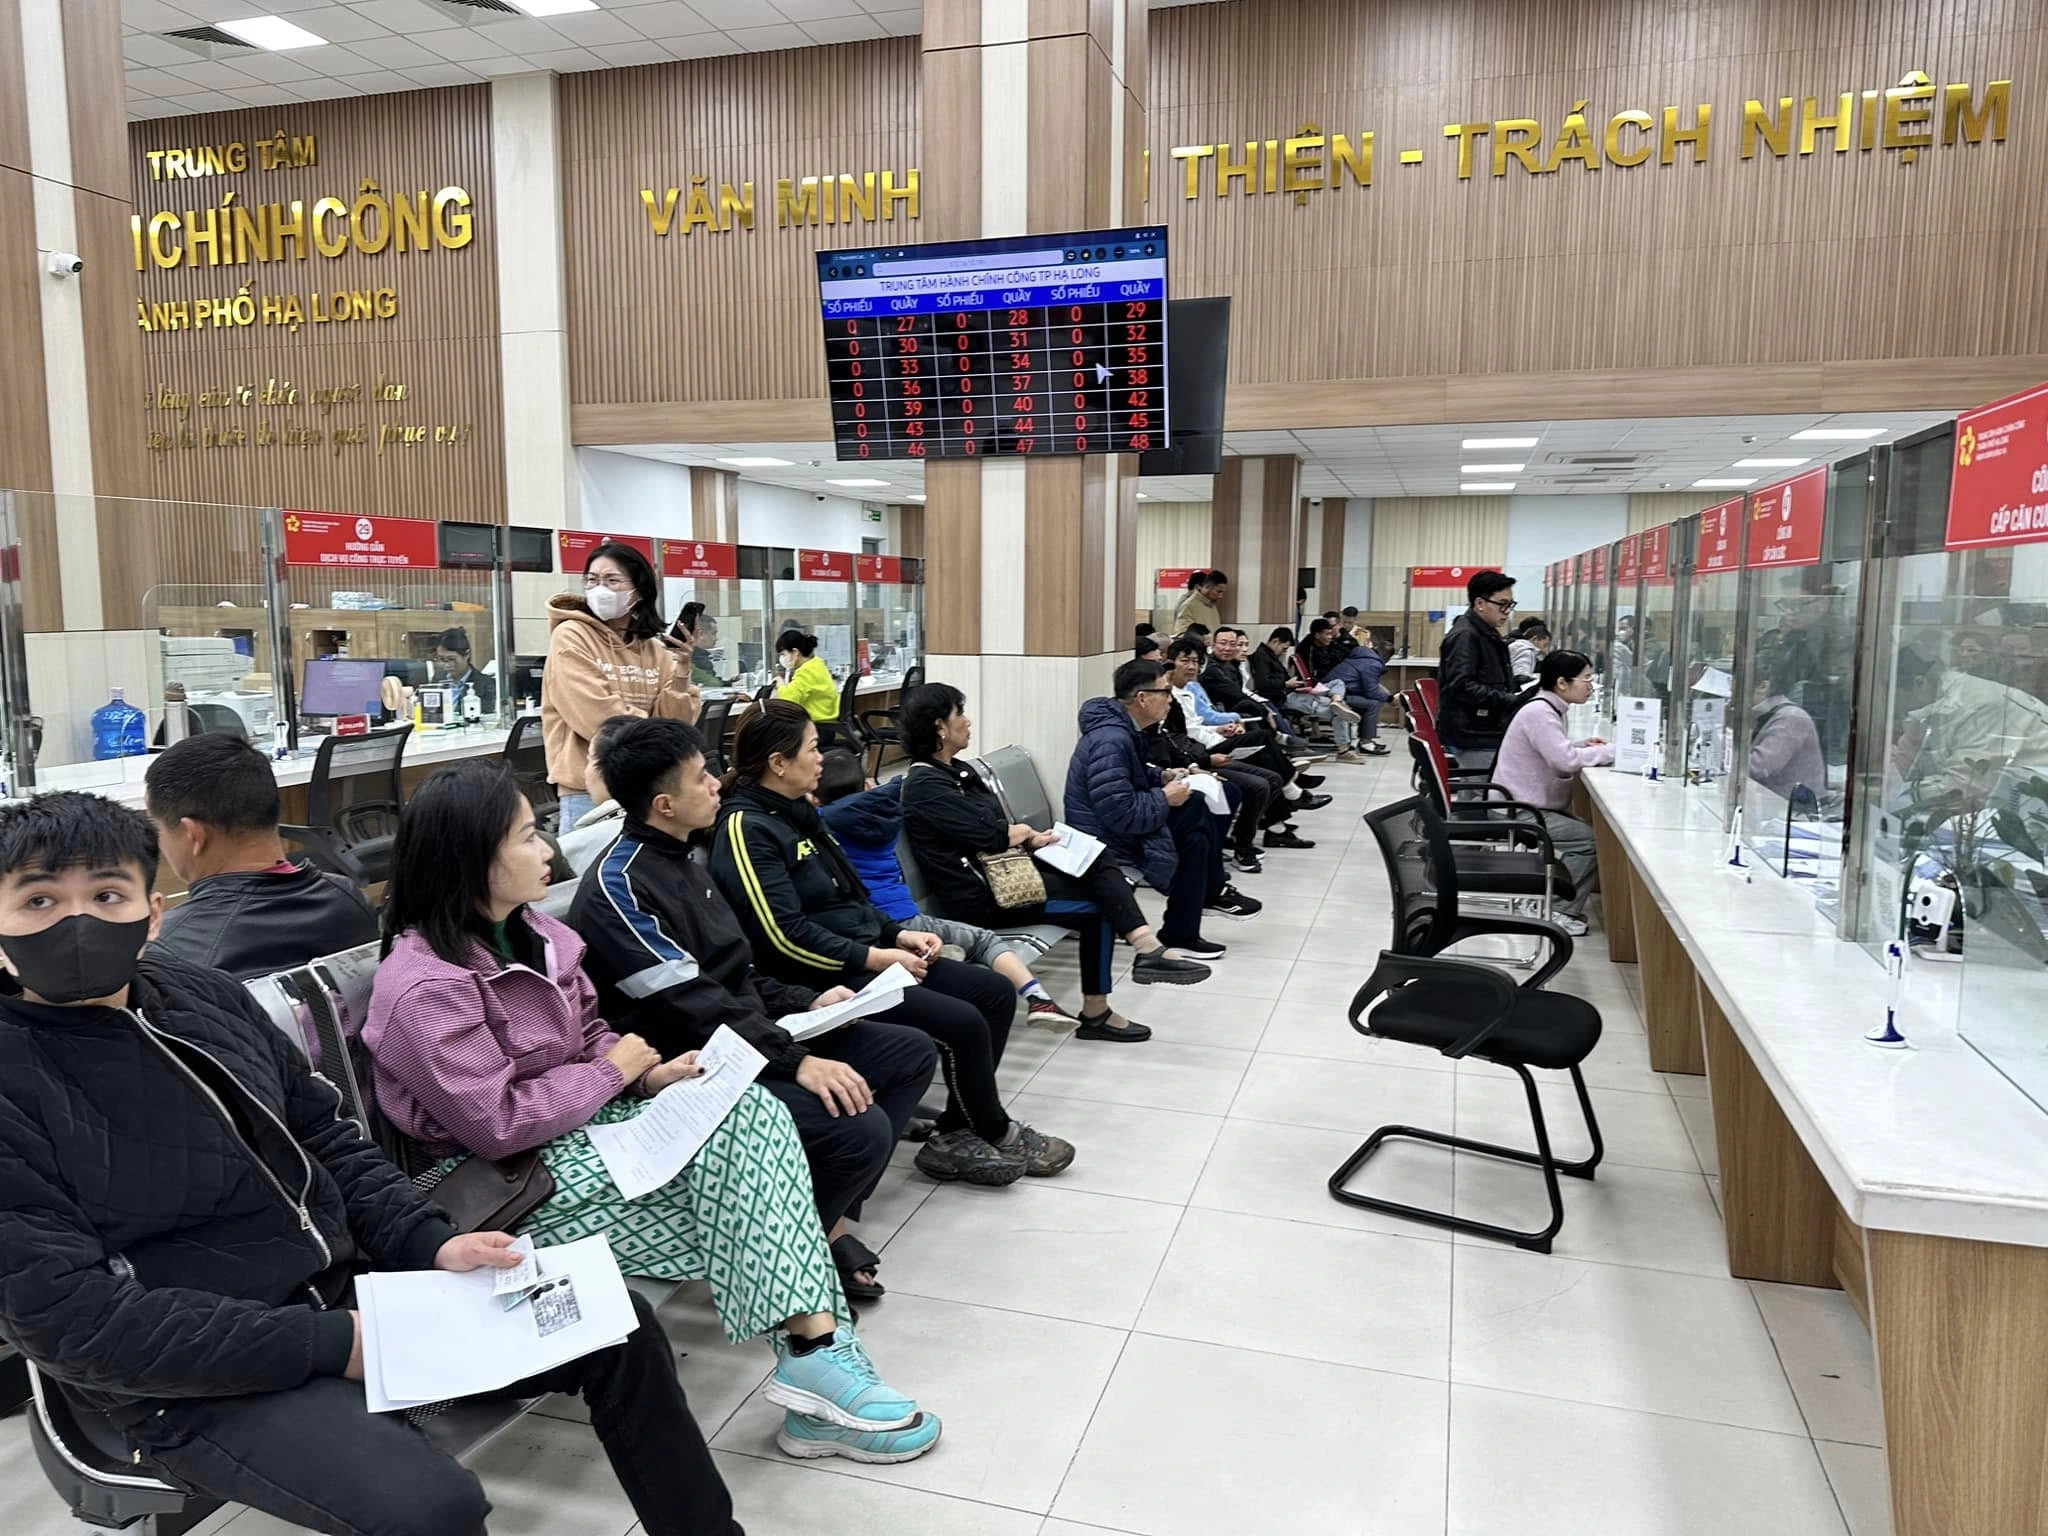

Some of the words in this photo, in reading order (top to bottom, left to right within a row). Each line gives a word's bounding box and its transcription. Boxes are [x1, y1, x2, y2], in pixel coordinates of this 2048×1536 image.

[1172, 123, 1375, 206] THIỆN
[1443, 100, 1712, 180] TRÁCH
[1741, 70, 2012, 165] NHIỆM
[147, 142, 247, 181] TRUNG
[256, 129, 318, 171] TÂM
[641, 176, 754, 236] VĂN
[778, 168, 920, 228] MINH
[149, 191, 306, 270] CHÍNH
[312, 178, 474, 259] CÔNG
[880, 279, 914, 292] TRUNG
[915, 276, 938, 290] TÂM
[940, 273, 970, 288] HÀNH
[971, 270, 1004, 286] CHÍNH
[1006, 270, 1037, 284] CÔNG
[1038, 269, 1051, 281] TP
[1054, 268, 1070, 282] HẠ
[1071, 266, 1101, 280] LONG
[195, 279, 256, 330] PHỐ
[262, 294, 305, 333] HẠ
[311, 287, 398, 324] LONG
[827, 297, 842, 314] SỐ
[843, 296, 873, 312] PHIẾU
[890, 295, 919, 311] QUẦY
[936, 292, 952, 308] SỐ
[952, 290, 984, 306] PHIẾU
[1003, 288, 1032, 303] QUẦY
[1051, 285, 1066, 300] SỐ
[1067, 283, 1100, 299] PHIẾU
[1120, 280, 1151, 296] QUẦY
[847, 319, 857, 334] 0
[896, 316, 915, 331] 27
[956, 313, 967, 328] 0
[1009, 309, 1029, 326] 28
[1071, 306, 1082, 322] 0
[1127, 302, 1146, 319] 29
[849, 341, 860, 356] 0
[899, 337, 918, 353] 30
[958, 335, 968, 350] 0
[1011, 332, 1028, 348] 31
[1072, 328, 1083, 344] 0
[1127, 324, 1146, 341] 32
[851, 361, 861, 376] 0
[901, 359, 919, 374] 33
[959, 357, 970, 371] 0
[1011, 354, 1030, 369] 34
[1072, 351, 1084, 366] 0
[1128, 347, 1147, 363] 35
[854, 382, 863, 397] 0
[903, 380, 921, 395] 36
[961, 378, 972, 393] 0
[1013, 375, 1031, 390] 37
[1073, 373, 1085, 388] 0
[1128, 369, 1148, 385] 38
[855, 403, 865, 418] 0
[904, 401, 923, 415] 39
[962, 399, 973, 414] 0
[1014, 396, 1033, 412] 40
[1074, 394, 1086, 410] 0
[1128, 391, 1149, 407] 42
[857, 424, 867, 438] 0
[906, 421, 924, 436] 43
[963, 420, 974, 434] 0
[1014, 418, 1034, 433] 44
[1075, 415, 1087, 430] 0
[1128, 412, 1149, 428] 45
[859, 443, 870, 458] 0
[908, 442, 926, 456] 46
[965, 440, 976, 455] 0
[1015, 438, 1034, 453] 47
[1076, 436, 1087, 451] 0
[1129, 434, 1150, 449] 48
[1990, 504, 2011, 533] CẤP
[2011, 503, 2033, 531] CĂN
